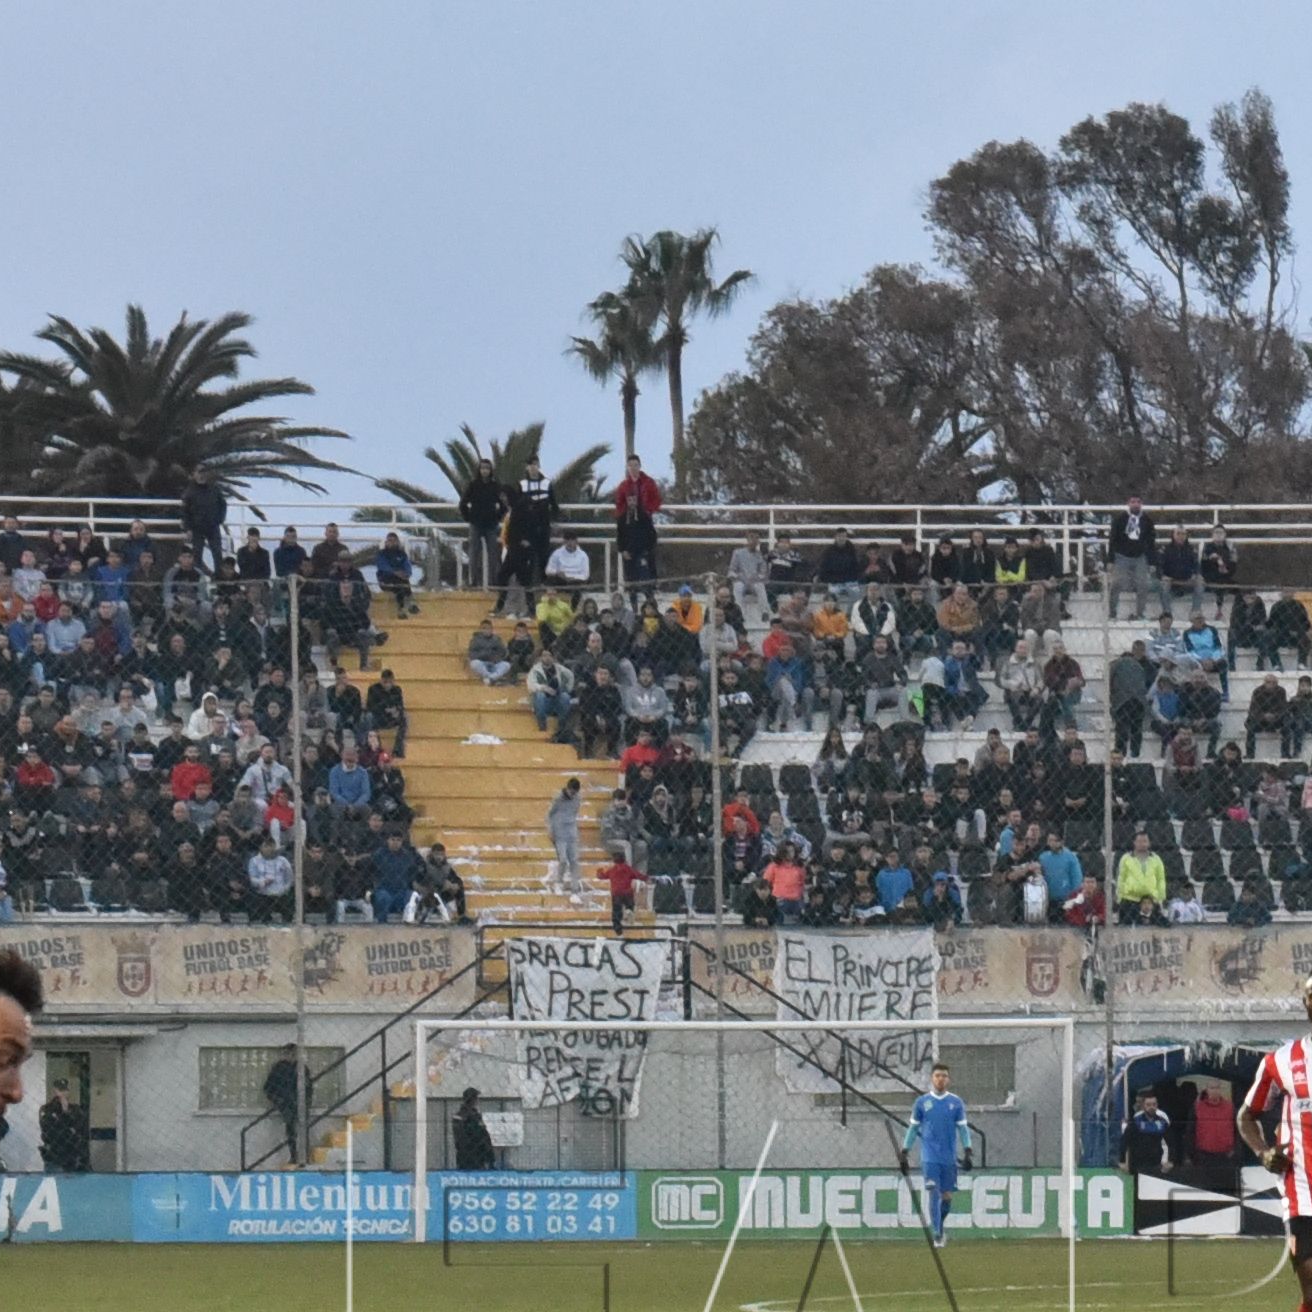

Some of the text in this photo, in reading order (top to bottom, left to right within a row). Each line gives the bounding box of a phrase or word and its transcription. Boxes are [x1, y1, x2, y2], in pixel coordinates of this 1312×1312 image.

[184, 937, 250, 961] UNIDOS
[365, 938, 432, 961] UNIDOS
[50, 952, 84, 969] BASE
[185, 954, 270, 976] FUTBOL BASE
[368, 955, 452, 976] FUTBOL BASE
[785, 938, 832, 985] EL
[208, 1174, 432, 1212] Millenium
[449, 1191, 619, 1211] 956 52 22 49
[657, 1184, 718, 1222] MC
[448, 1214, 615, 1234] 630 81 03 41
